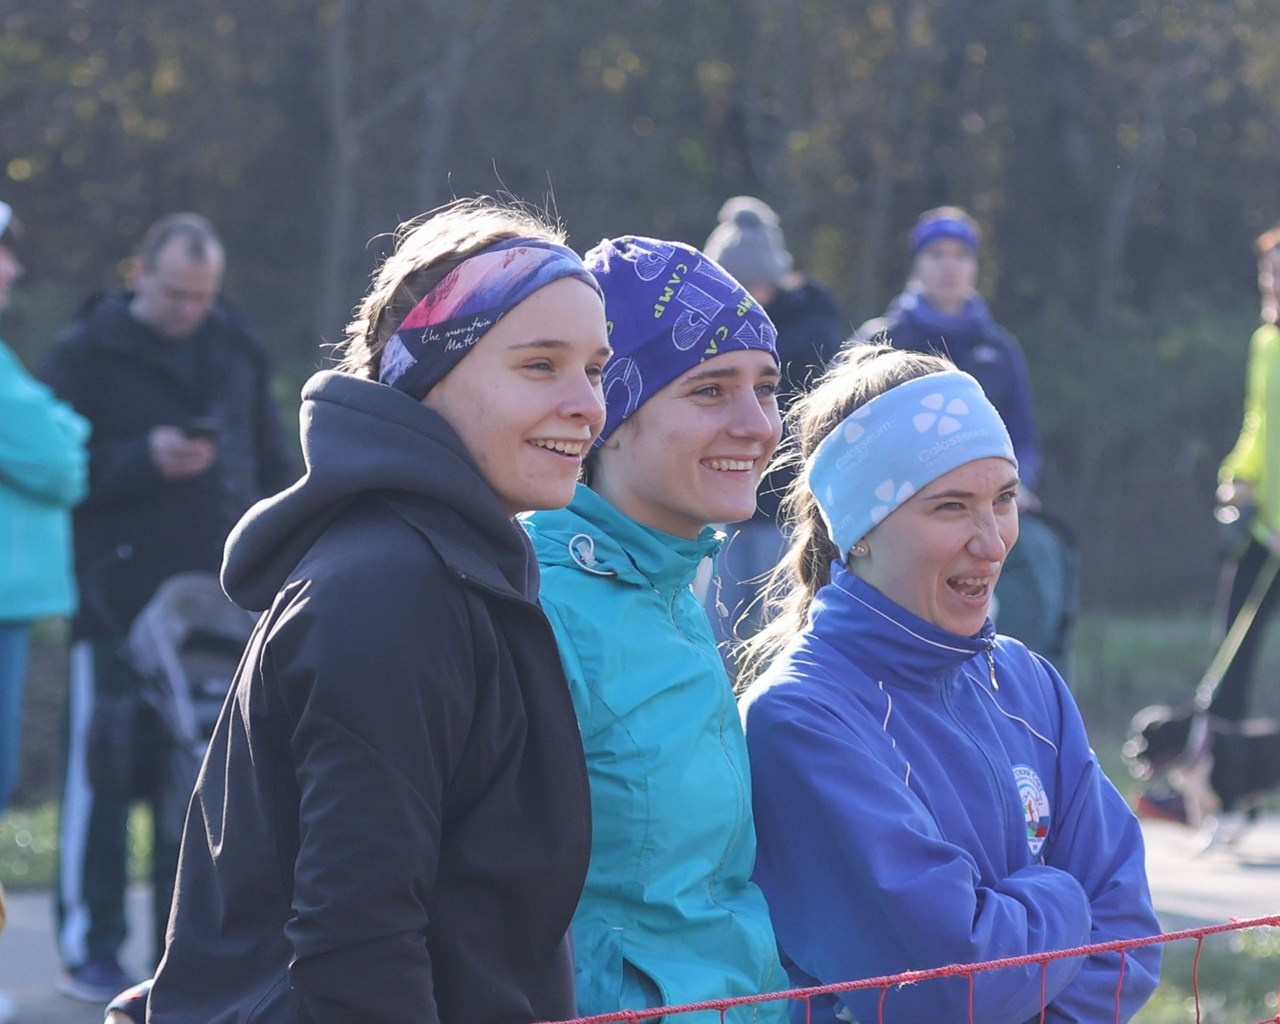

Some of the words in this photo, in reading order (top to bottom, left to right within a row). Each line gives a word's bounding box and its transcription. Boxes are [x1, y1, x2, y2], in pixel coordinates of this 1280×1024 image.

[654, 263, 688, 319] CAMP
[420, 327, 441, 345] the
[919, 427, 991, 462] Colosseum
